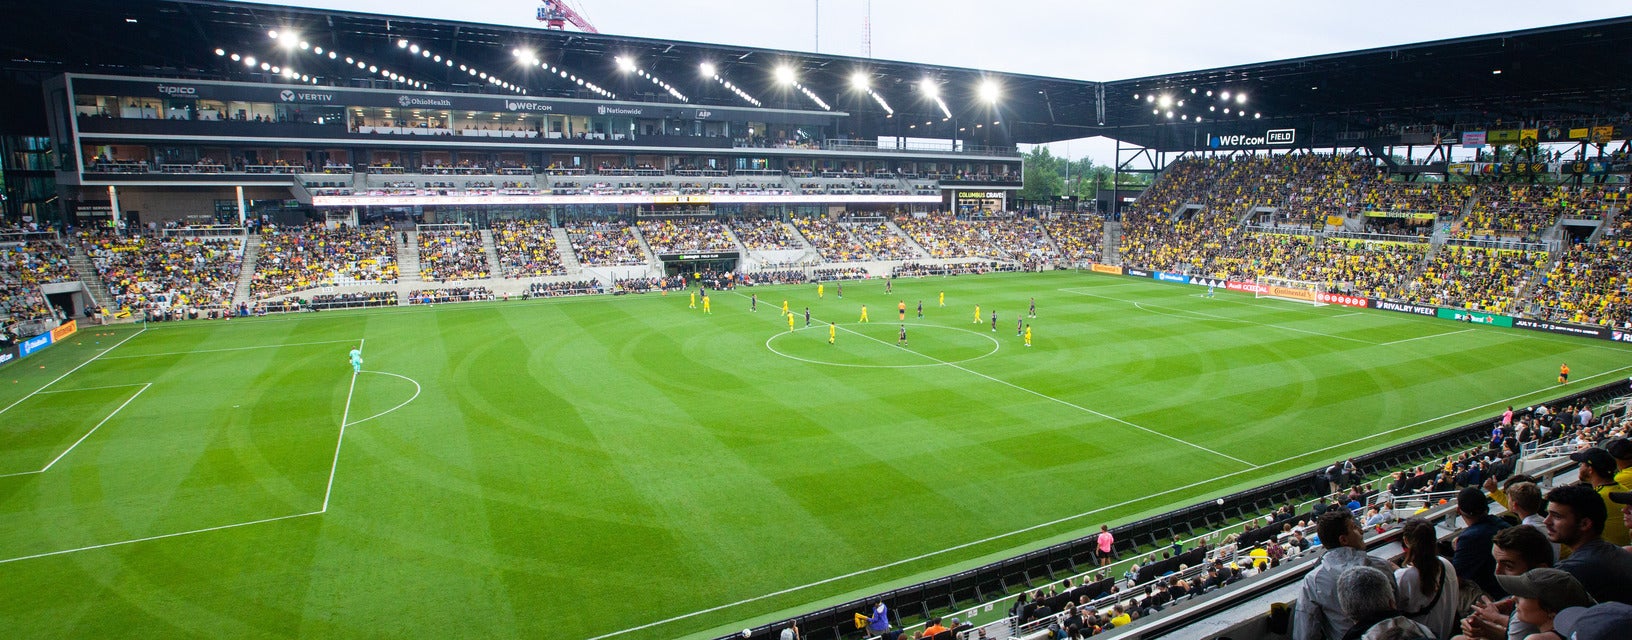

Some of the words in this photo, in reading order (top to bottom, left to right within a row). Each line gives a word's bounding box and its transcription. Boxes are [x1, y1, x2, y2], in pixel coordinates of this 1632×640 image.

[157, 84, 196, 95] tipico
[298, 93, 332, 102] VERTIV
[411, 98, 451, 106] OhioHealth
[607, 107, 642, 115] Nationwide
[1270, 132, 1291, 141] FIELD
[1274, 287, 1306, 297] Continental
[1383, 302, 1413, 313] RIVALRY
[1413, 306, 1435, 316] WEEK
